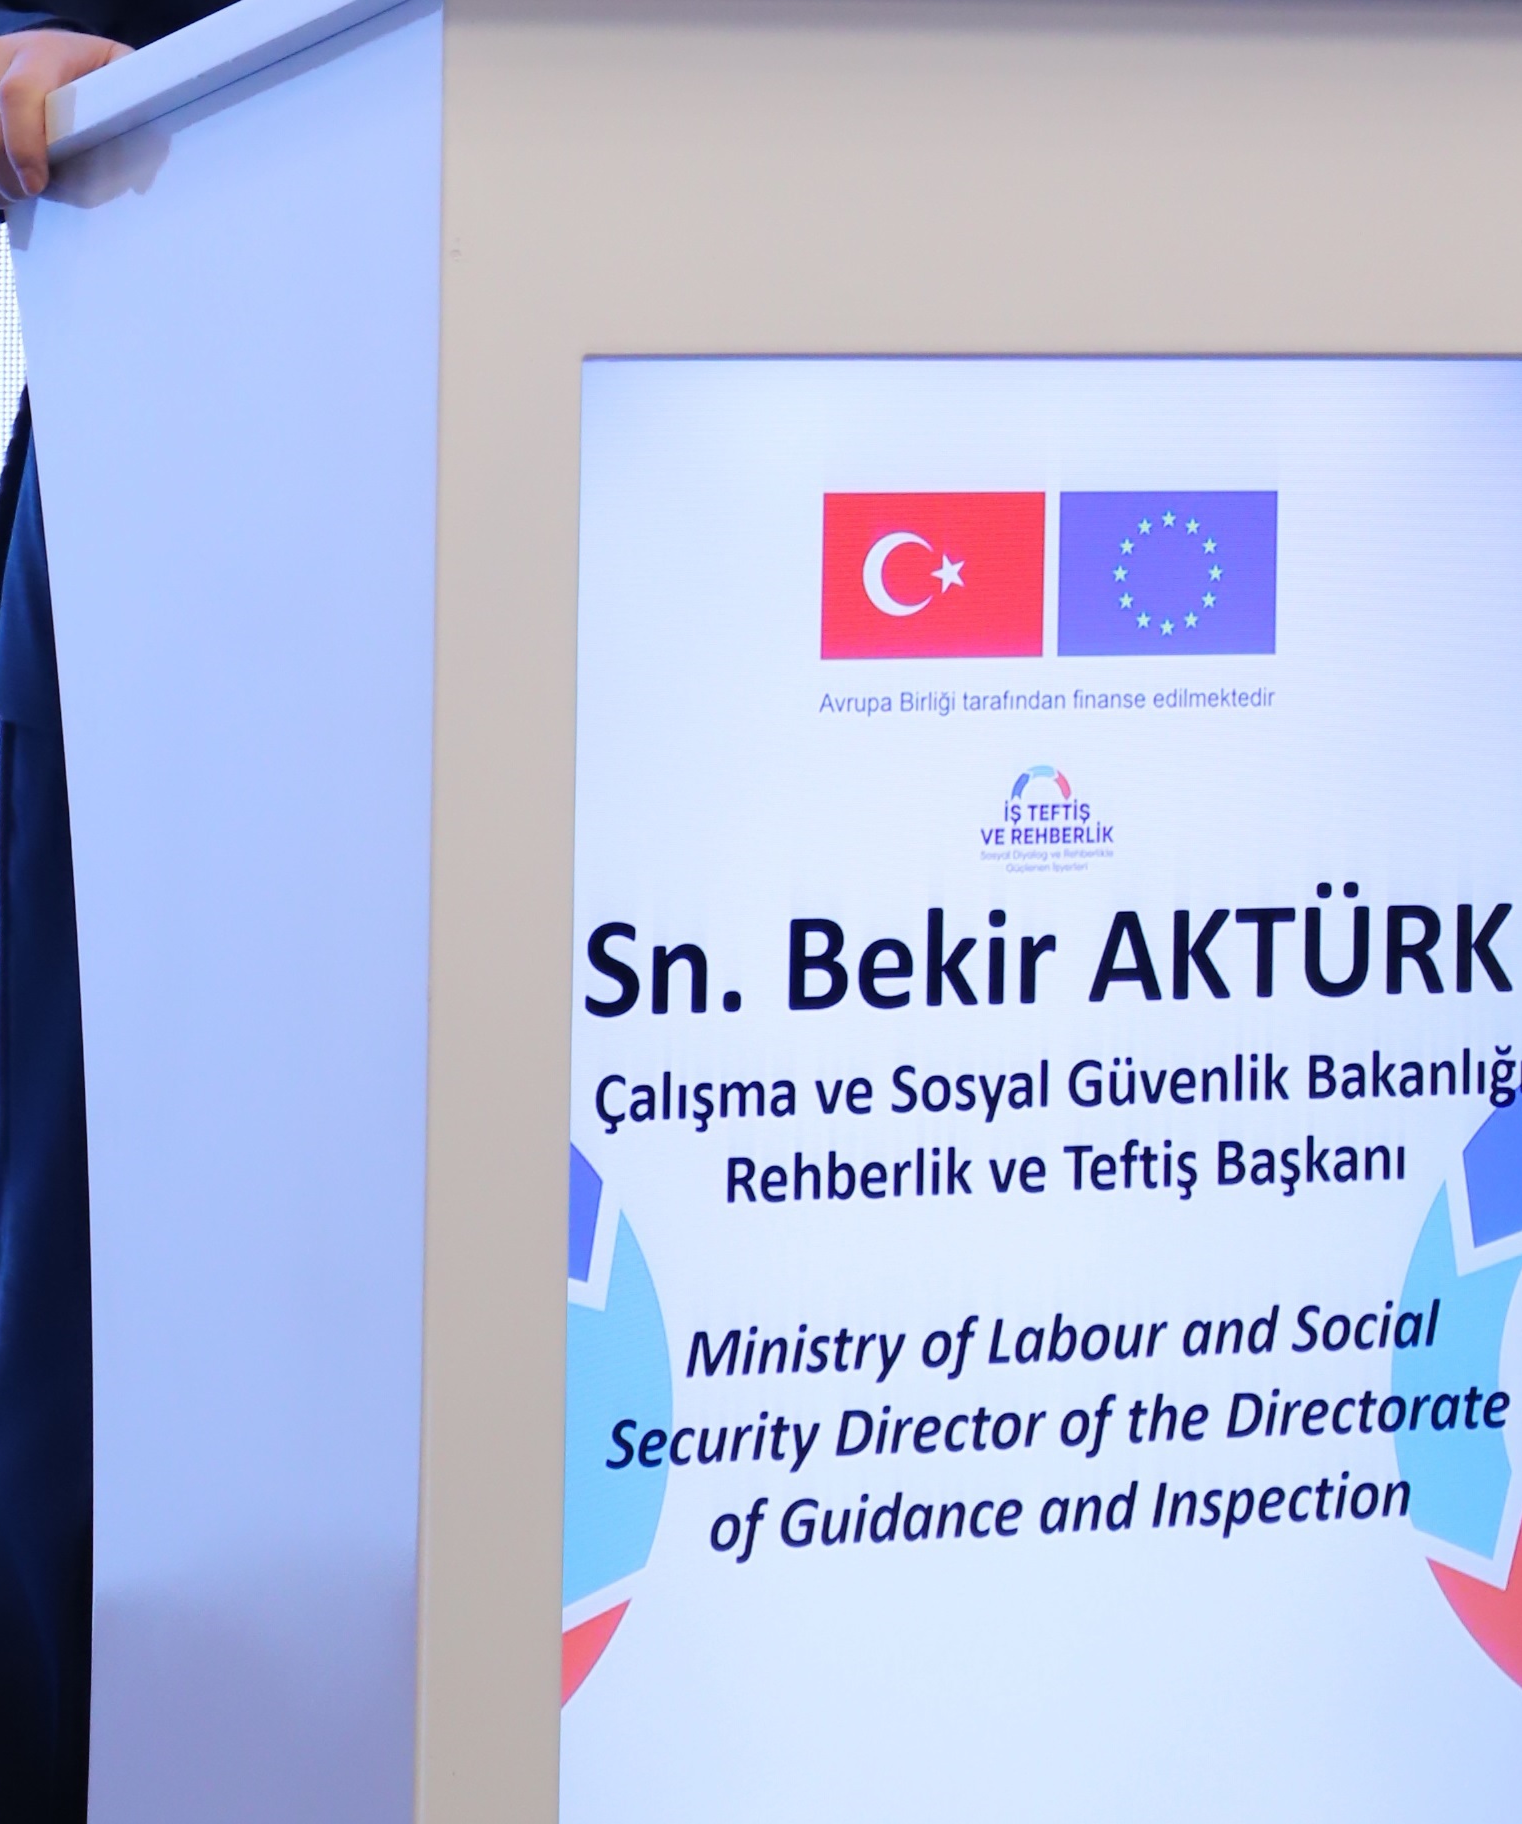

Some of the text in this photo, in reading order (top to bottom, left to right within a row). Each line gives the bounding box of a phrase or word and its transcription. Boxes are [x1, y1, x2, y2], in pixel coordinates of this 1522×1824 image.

[820, 688, 1275, 716] Avrupa Birliği tarafından finanse edilmektedir
[981, 821, 1114, 844] VE REHBERLİK
[1005, 800, 1090, 824] İŞ TEFTİŞ
[586, 882, 1512, 1017] Sn. Bekir AKTÜRK
[596, 1072, 795, 1134] Çalışma
[816, 1078, 872, 1114] ve
[892, 1060, 1048, 1122] Sosyal
[1069, 1053, 1288, 1107] Güvenlik
[728, 1135, 1404, 1202] Rehberlik ve Teftiş Başkanı
[687, 1299, 1440, 1382] Ministry of Labour and Social
[606, 1386, 1509, 1472] Security Director of the Directorate
[711, 1471, 1410, 1563] of Guidance and Inspection
